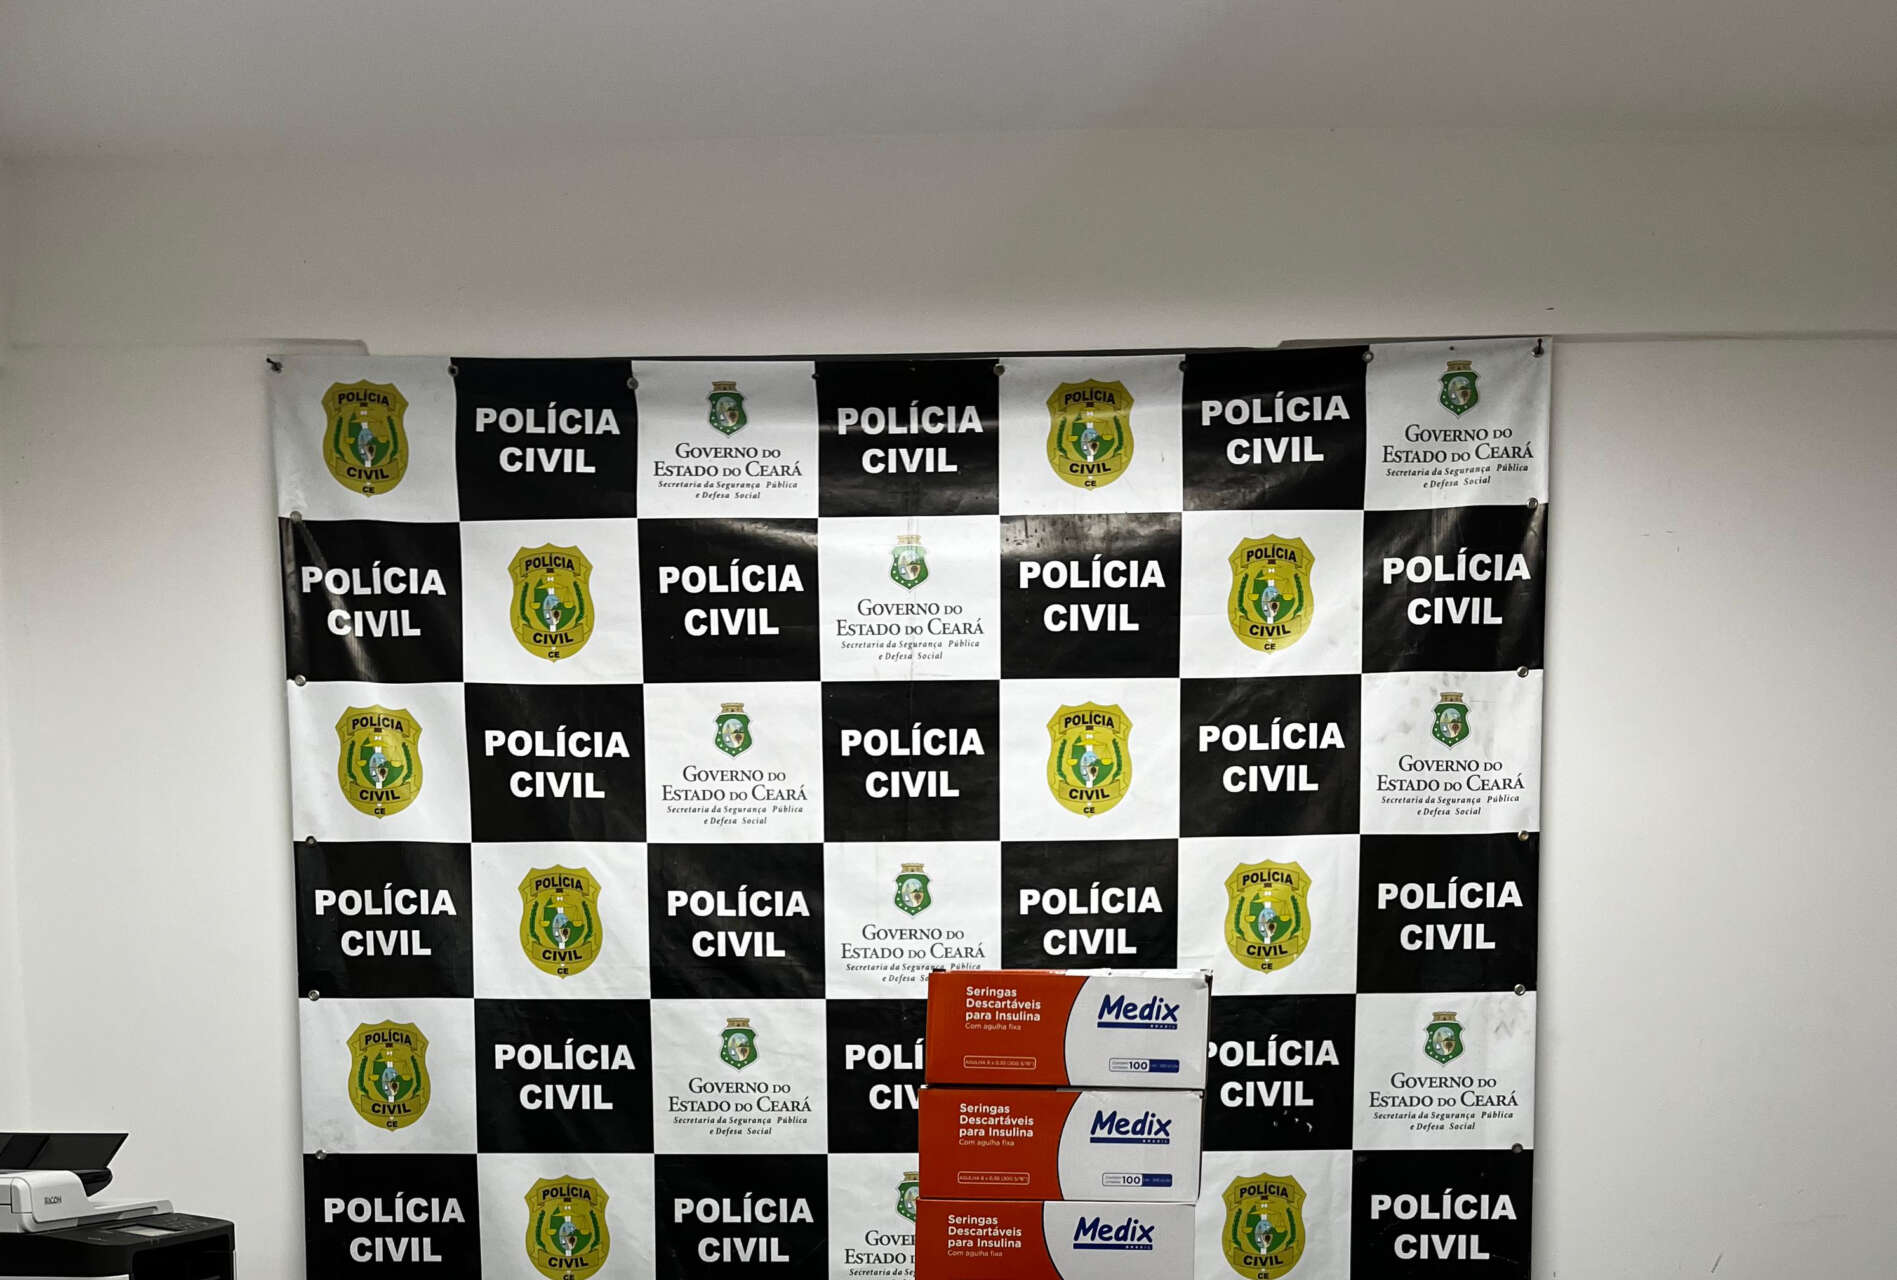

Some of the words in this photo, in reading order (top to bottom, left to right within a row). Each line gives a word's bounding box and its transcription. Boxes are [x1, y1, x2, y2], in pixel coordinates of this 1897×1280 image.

[338, 389, 389, 406] POLÍCIA
[1201, 389, 1350, 426] POLÍCIA
[476, 401, 621, 435] POLÍCIA
[837, 399, 984, 435] POLÍCIA
[499, 446, 596, 474] CIVIL
[675, 443, 758, 458] GOVERNO
[762, 449, 781, 458] DO
[861, 447, 958, 474] CIVIL
[1226, 435, 1325, 465] CIVIL
[346, 467, 389, 480] CIVIL
[653, 461, 718, 477] ESTADO
[722, 467, 741, 477] DO
[745, 460, 802, 477] CEARÁ
[658, 480, 701, 488] Secretaria
[704, 480, 714, 488] da
[716, 481, 761, 490] Segurança
[766, 480, 798, 489] Pública
[702, 491, 730, 500] Defesa
[734, 491, 761, 499] Social
[301, 560, 447, 596] POLÍCIA
[658, 558, 805, 594] POLÍCIA
[1019, 553, 1166, 589] POLÍCIA
[1382, 547, 1532, 585] POLÍCIA
[327, 609, 421, 638] CIVIL
[684, 607, 780, 637] CIVIL
[1043, 603, 1140, 632] CIVIL
[1407, 596, 1503, 626] CIVIL
[484, 723, 631, 758] POLÍCIA
[840, 722, 985, 757] POLÍCIA
[1199, 716, 1346, 752] POLÍCIA
[1399, 754, 1479, 772] GOVERNO
[1484, 762, 1503, 771] DO
[509, 770, 606, 799] CIVIL
[865, 770, 960, 799] CIVIL
[1222, 764, 1319, 793] CIVIL
[1377, 774, 1440, 791] ESTADO
[1444, 782, 1462, 791] DO
[1467, 773, 1525, 791] CEARÁ
[535, 873, 583, 890] POLÍCIA
[1377, 874, 1524, 910] POLÍCIA
[314, 882, 457, 916] POLÍCIA
[667, 884, 810, 918] POLÍCIA
[1019, 880, 1163, 915] POLÍCIA
[340, 929, 432, 957] CIVIL
[692, 930, 786, 958] CIVIL
[1043, 928, 1137, 956] CIVIL
[1400, 923, 1496, 951] CIVIL
[542, 949, 582, 961] CIVIL
[966, 986, 1017, 998] Seringas
[966, 998, 1041, 1010] Descartáveis
[965, 1010, 992, 1022] para
[995, 1010, 1041, 1022] Insulina
[1098, 994, 1180, 1021] Medix
[965, 1022, 982, 1030] Com
[494, 1037, 636, 1070] POLÍCIA
[1129, 1061, 1148, 1071] 100
[519, 1083, 614, 1110] CIVIL
[1220, 1080, 1314, 1108] CIVIL
[1091, 1110, 1172, 1137] Medix
[1122, 1175, 1141, 1185] 100
[1240, 1182, 1288, 1198] POLÍCIA
[324, 1191, 466, 1223] POLÍCIA
[674, 1191, 814, 1224] POLÍCIA
[1370, 1187, 1517, 1220] POLÍCIA
[349, 1237, 442, 1263] CIVIL
[697, 1237, 790, 1263] CIVIL
[1243, 1255, 1283, 1266] CIVIL
[1394, 1233, 1490, 1260] CIVIL
